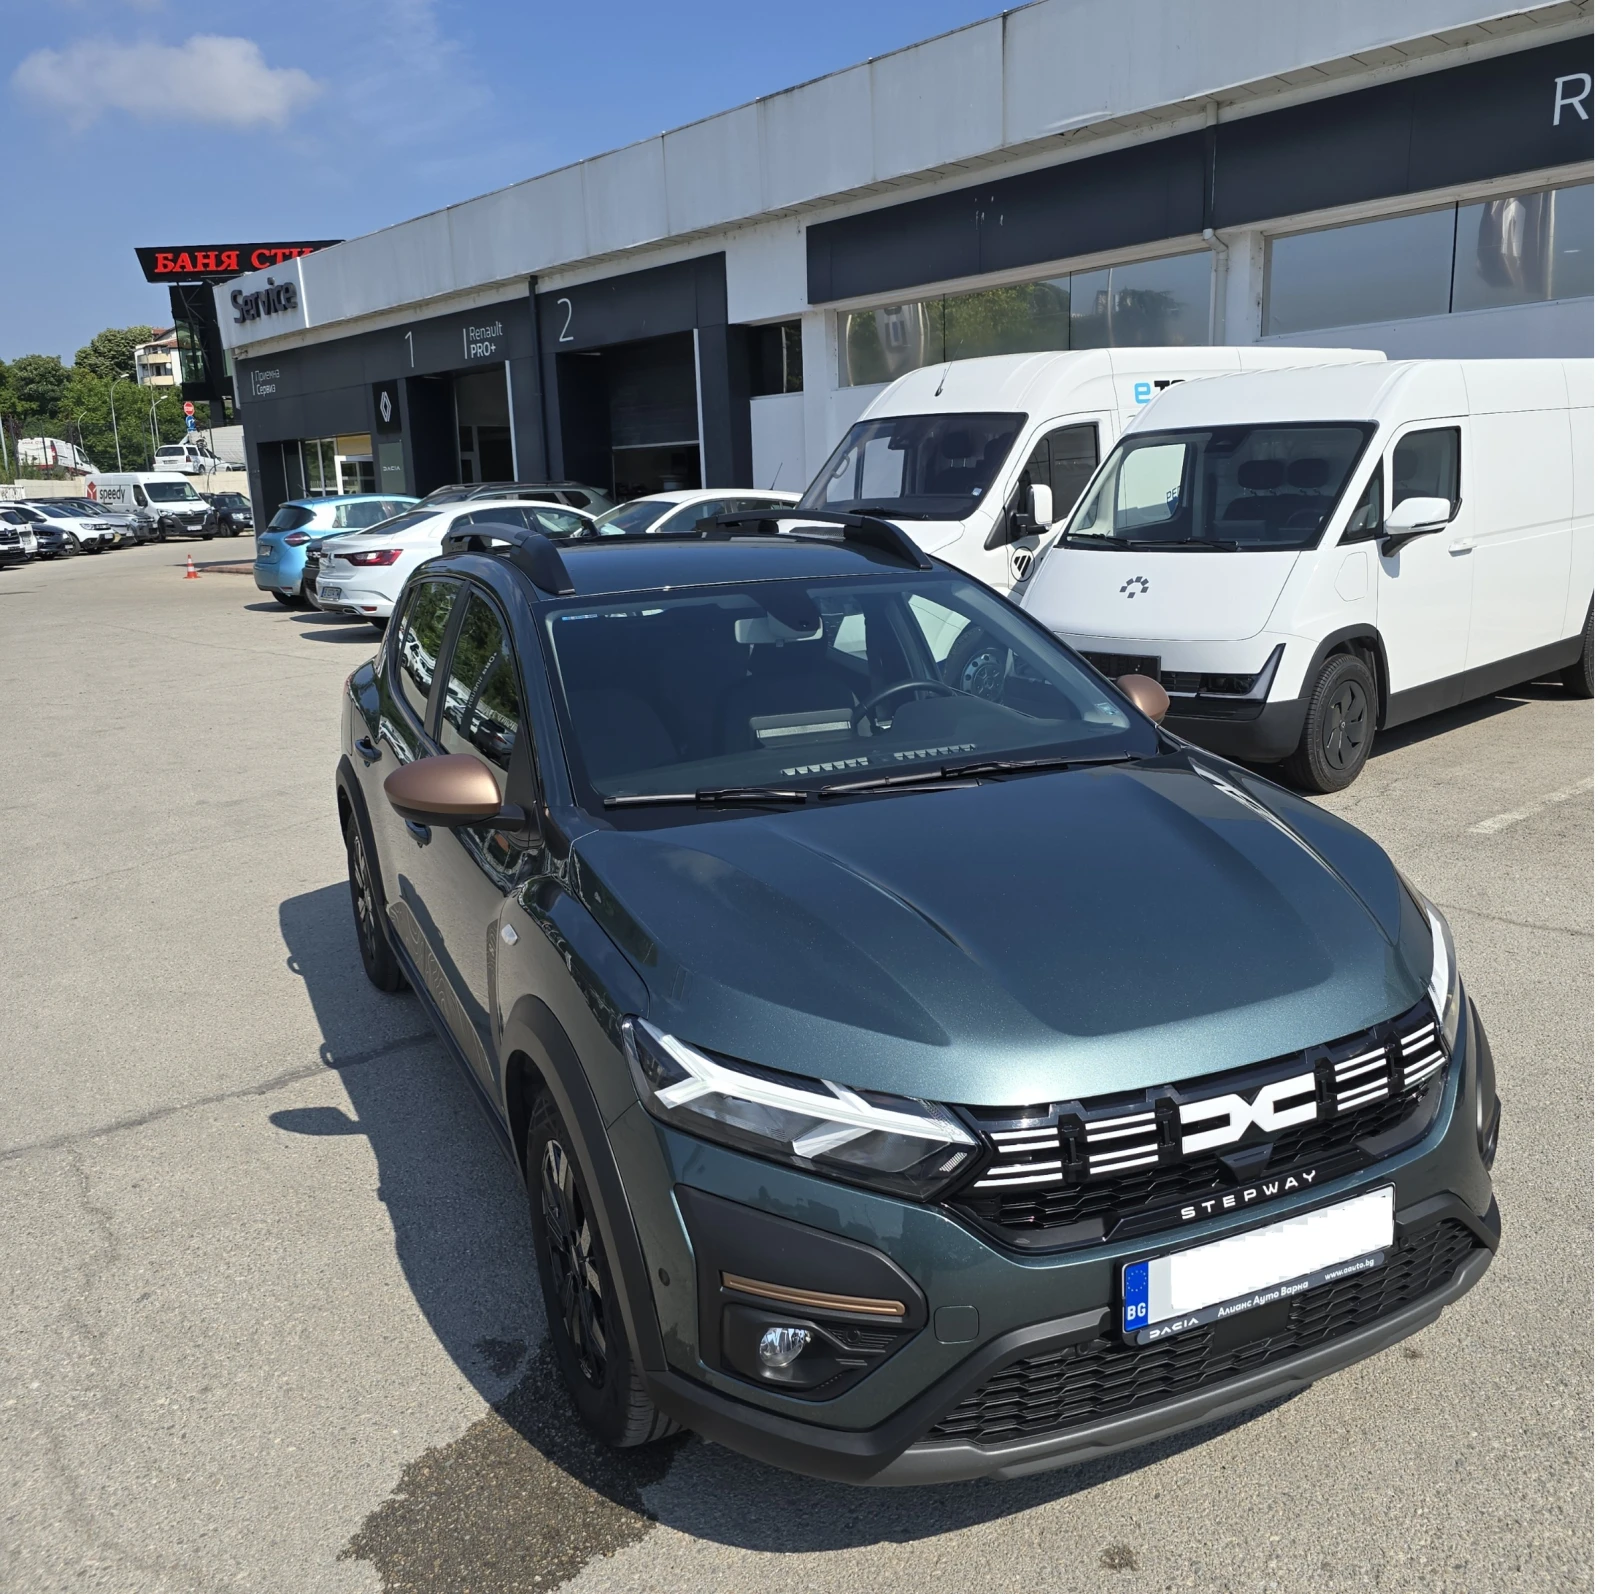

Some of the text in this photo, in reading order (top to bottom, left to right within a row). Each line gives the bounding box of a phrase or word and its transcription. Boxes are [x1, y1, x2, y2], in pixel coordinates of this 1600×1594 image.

[1553, 72, 1592, 126] R
[154, 247, 328, 273] БАНЯ СТ
[230, 277, 298, 324] Service
[469, 321, 503, 341] Renault
[557, 298, 574, 342] 2
[404, 330, 415, 368] 1
[470, 341, 496, 358] PRO+
[99, 485, 126, 503] speedy
[1180, 1169, 1316, 1220] STEPWAY
[1324, 1257, 1375, 1281] www.aauto.bg
[1126, 1302, 1147, 1321] BG
[1217, 1299, 1253, 1317] Алианс
[1280, 1280, 1309, 1298] Варна
[1149, 1317, 1199, 1339] DACIA
